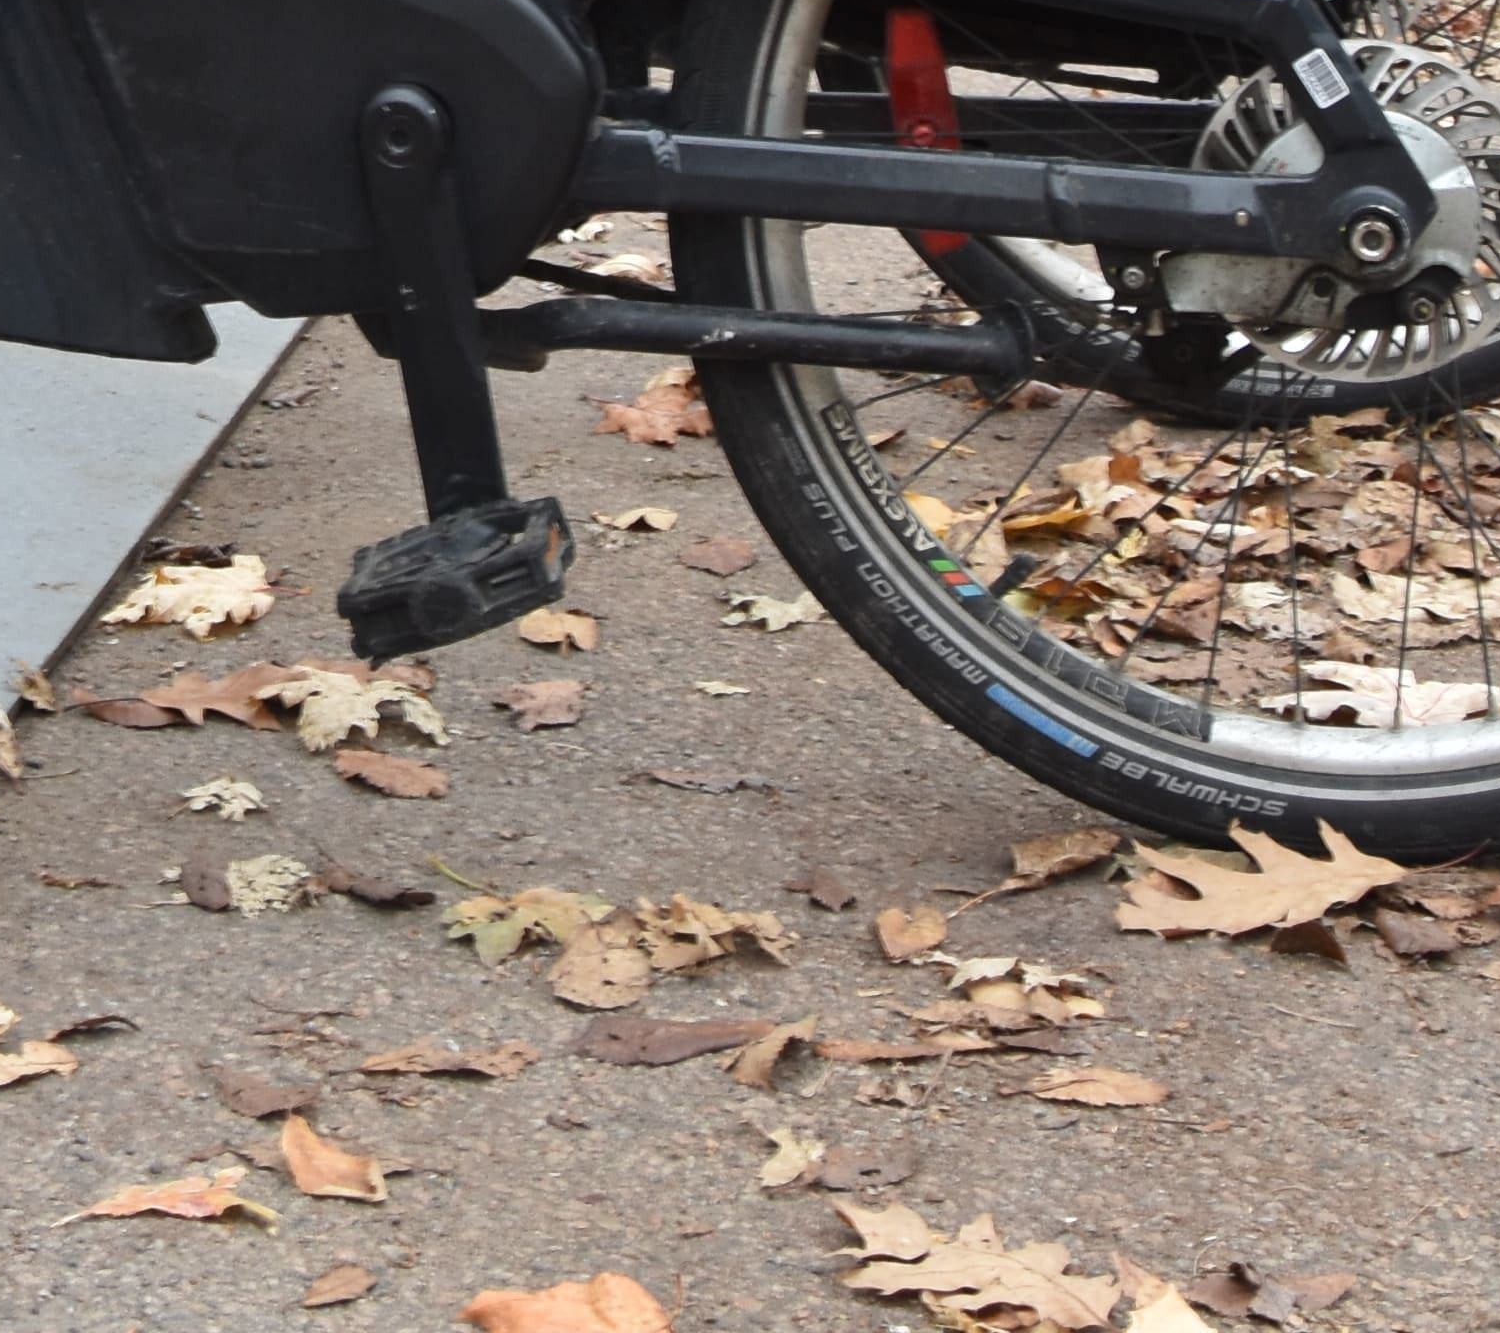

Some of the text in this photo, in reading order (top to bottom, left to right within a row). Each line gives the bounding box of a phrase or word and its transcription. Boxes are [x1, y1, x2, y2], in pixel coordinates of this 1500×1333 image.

[825, 407, 937, 553] ALEXRIMS
[804, 484, 1289, 818] SCHWALBE MARATHON PLUS
